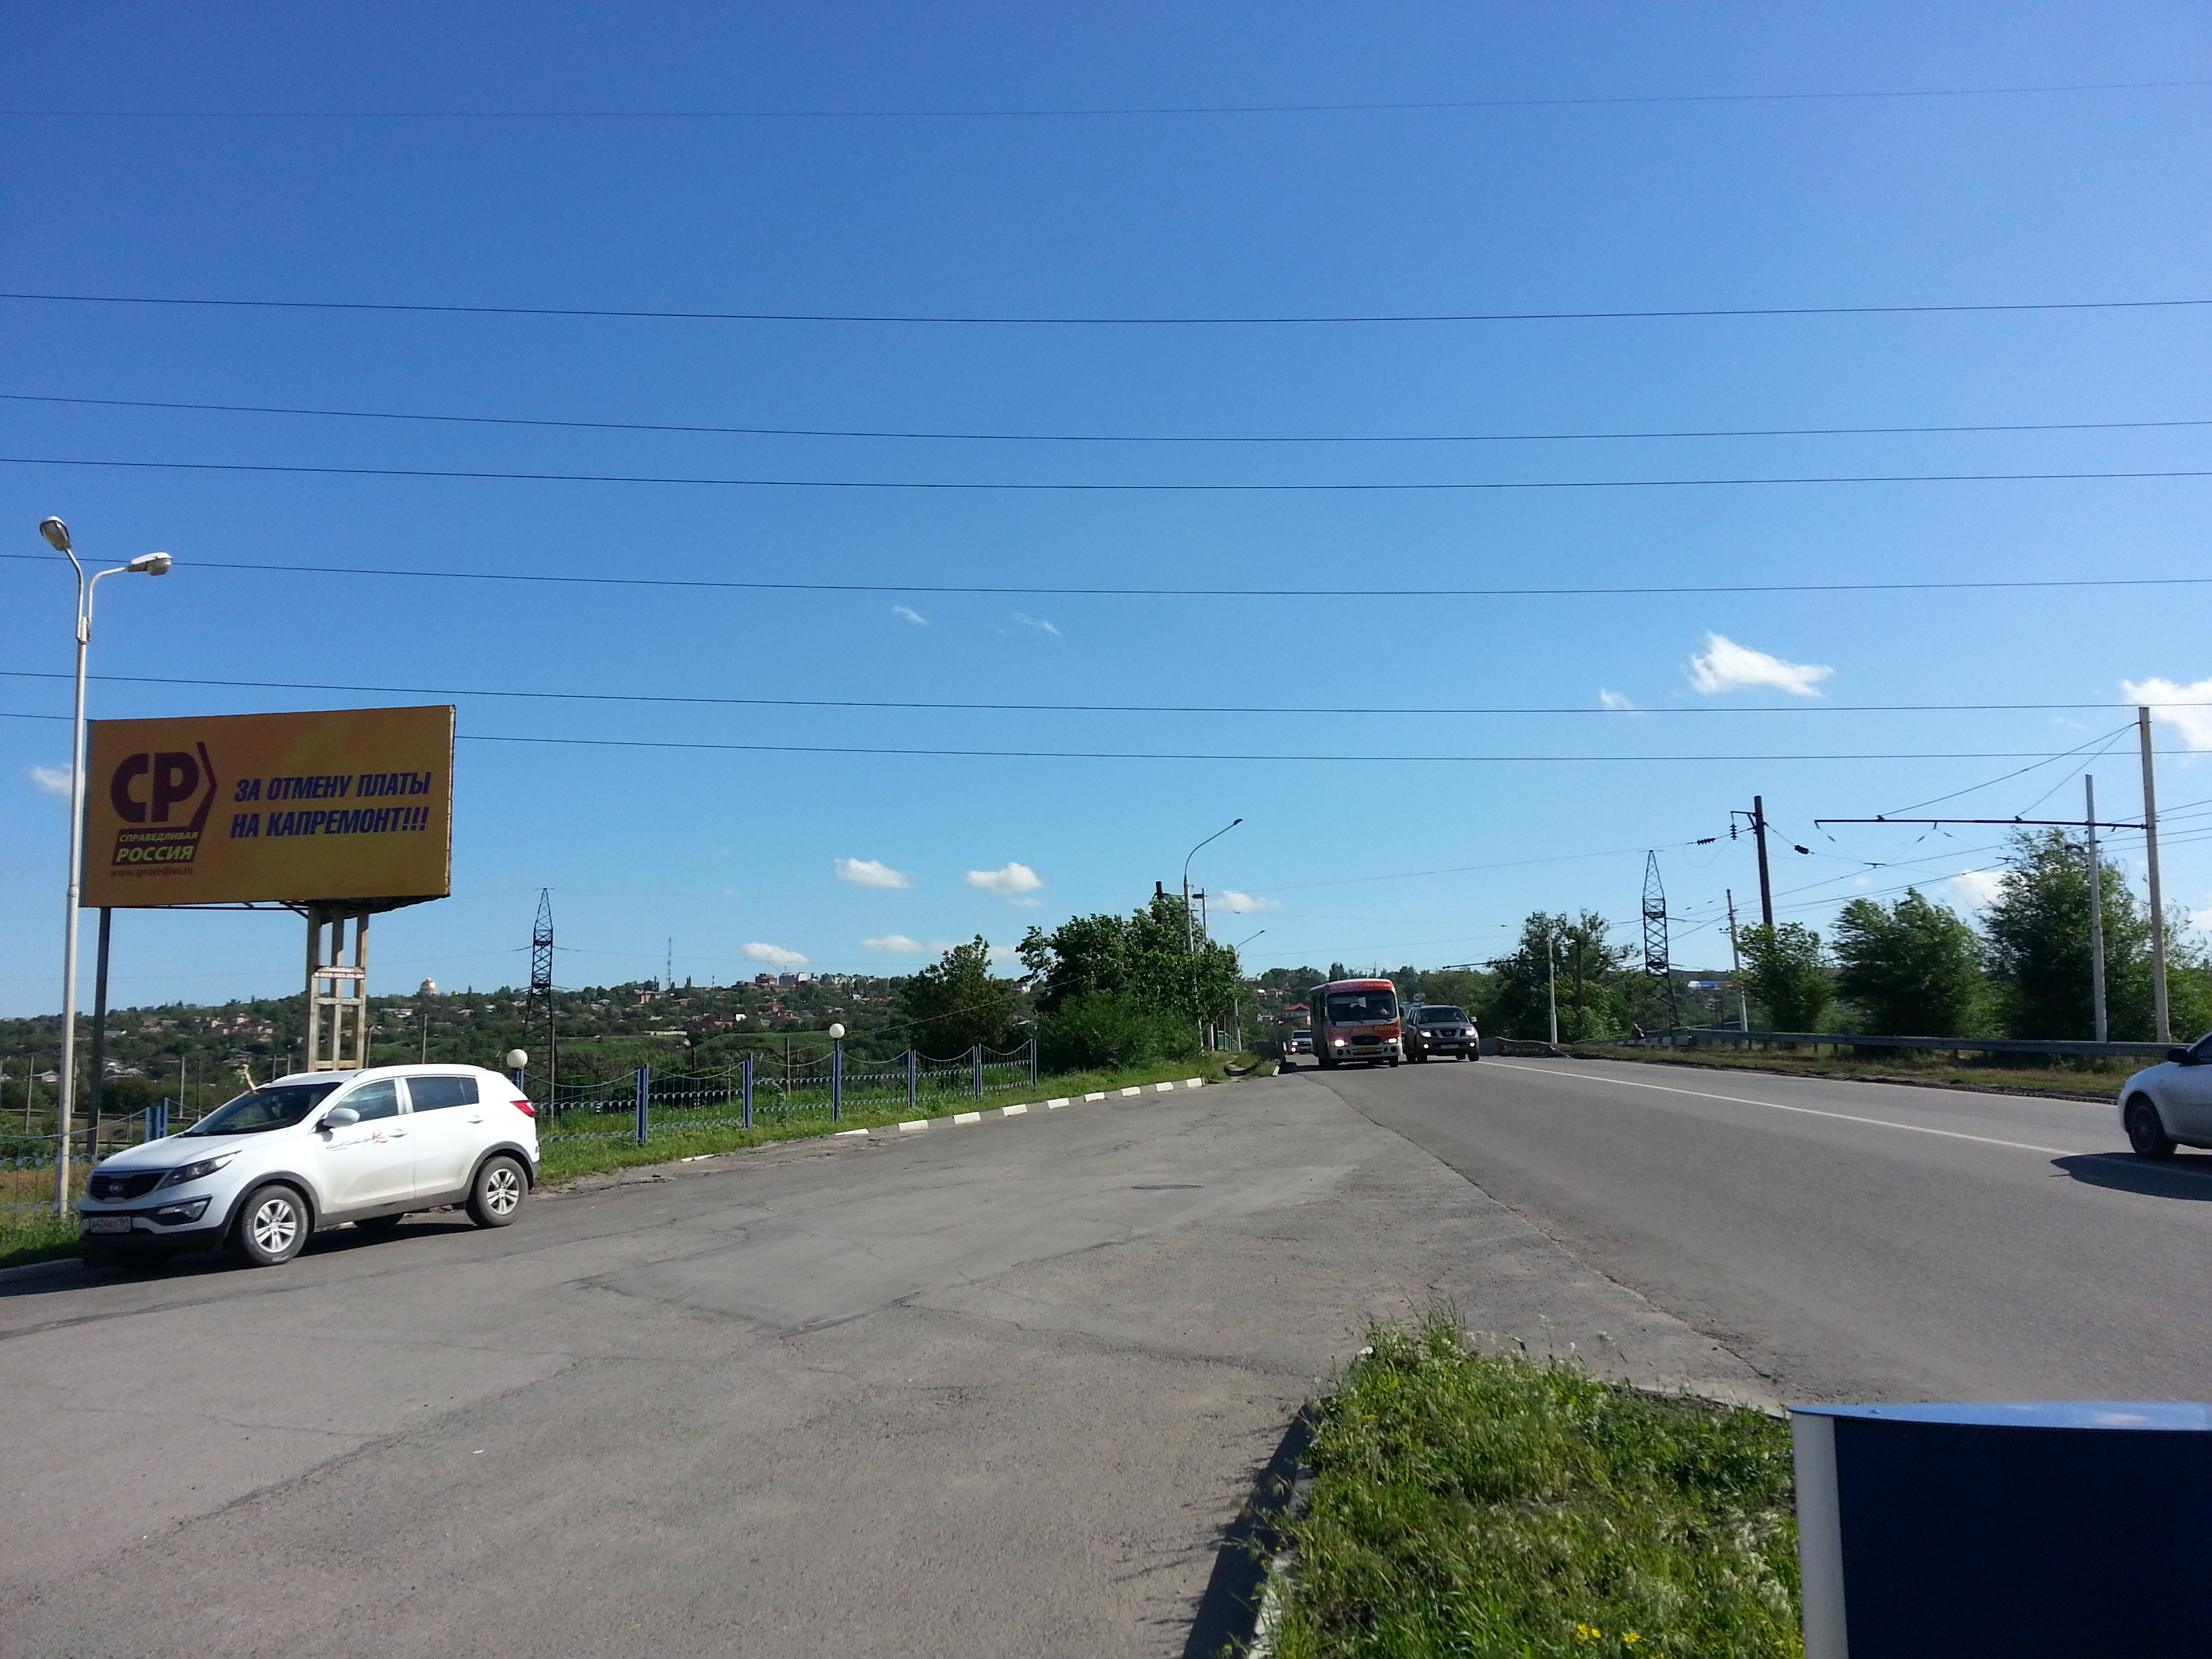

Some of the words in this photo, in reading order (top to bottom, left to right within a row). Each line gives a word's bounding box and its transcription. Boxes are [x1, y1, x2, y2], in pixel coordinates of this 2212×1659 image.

[110, 751, 200, 823] СР
[234, 779, 261, 802] ЗА
[266, 775, 353, 800] ОТМЕНУ
[356, 771, 432, 797] ПЛАТЫ
[119, 832, 199, 842] СПРАВЕДЛИВАЯ
[230, 813, 260, 838] НА
[266, 806, 430, 836] КАПРЕМОНТ!!!
[116, 845, 195, 863] РОССИЯ
